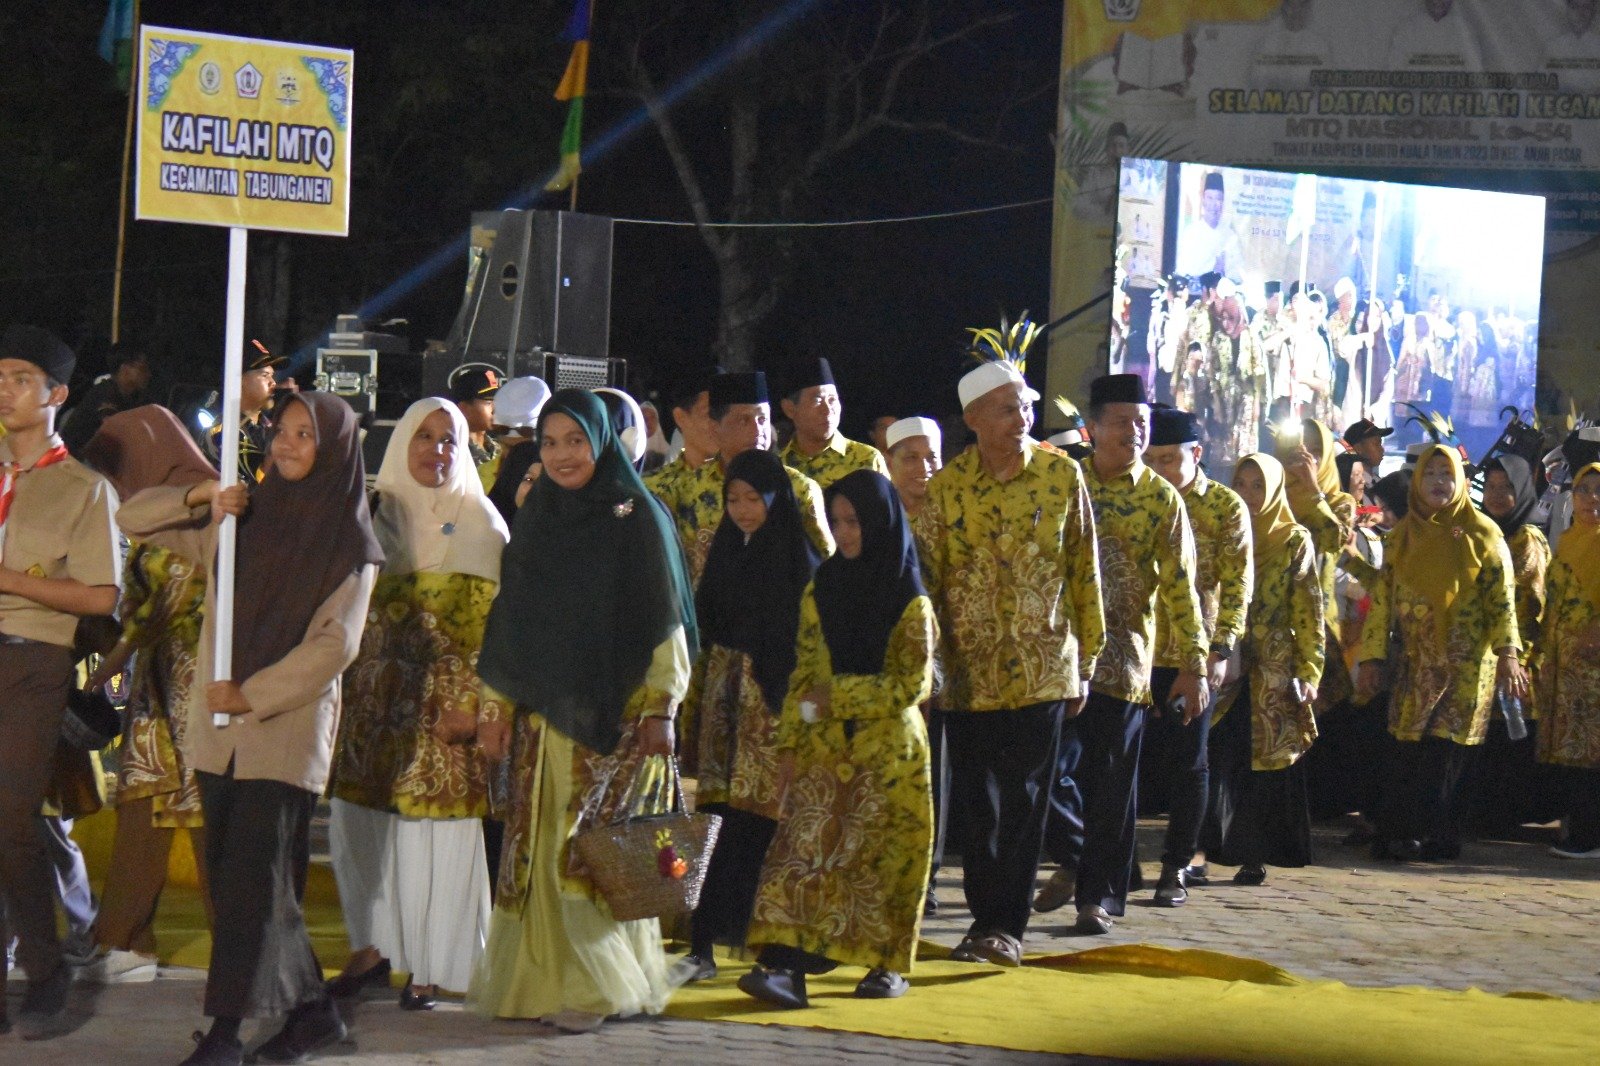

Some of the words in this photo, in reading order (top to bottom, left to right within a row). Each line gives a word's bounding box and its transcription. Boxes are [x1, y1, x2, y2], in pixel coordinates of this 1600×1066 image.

[1208, 88, 1313, 114] SELAMAT
[1318, 89, 1413, 116] DATANG
[1419, 91, 1520, 118] KAFILAH
[162, 110, 272, 160] KAFILAH
[277, 122, 335, 171] MTQ
[1285, 117, 1342, 141] MTQ
[1347, 118, 1480, 141] NASIONAL
[1311, 142, 1363, 158] KABUPATEN
[160, 162, 239, 197] KECAMATAN
[244, 170, 333, 204] TABUNGANEN
